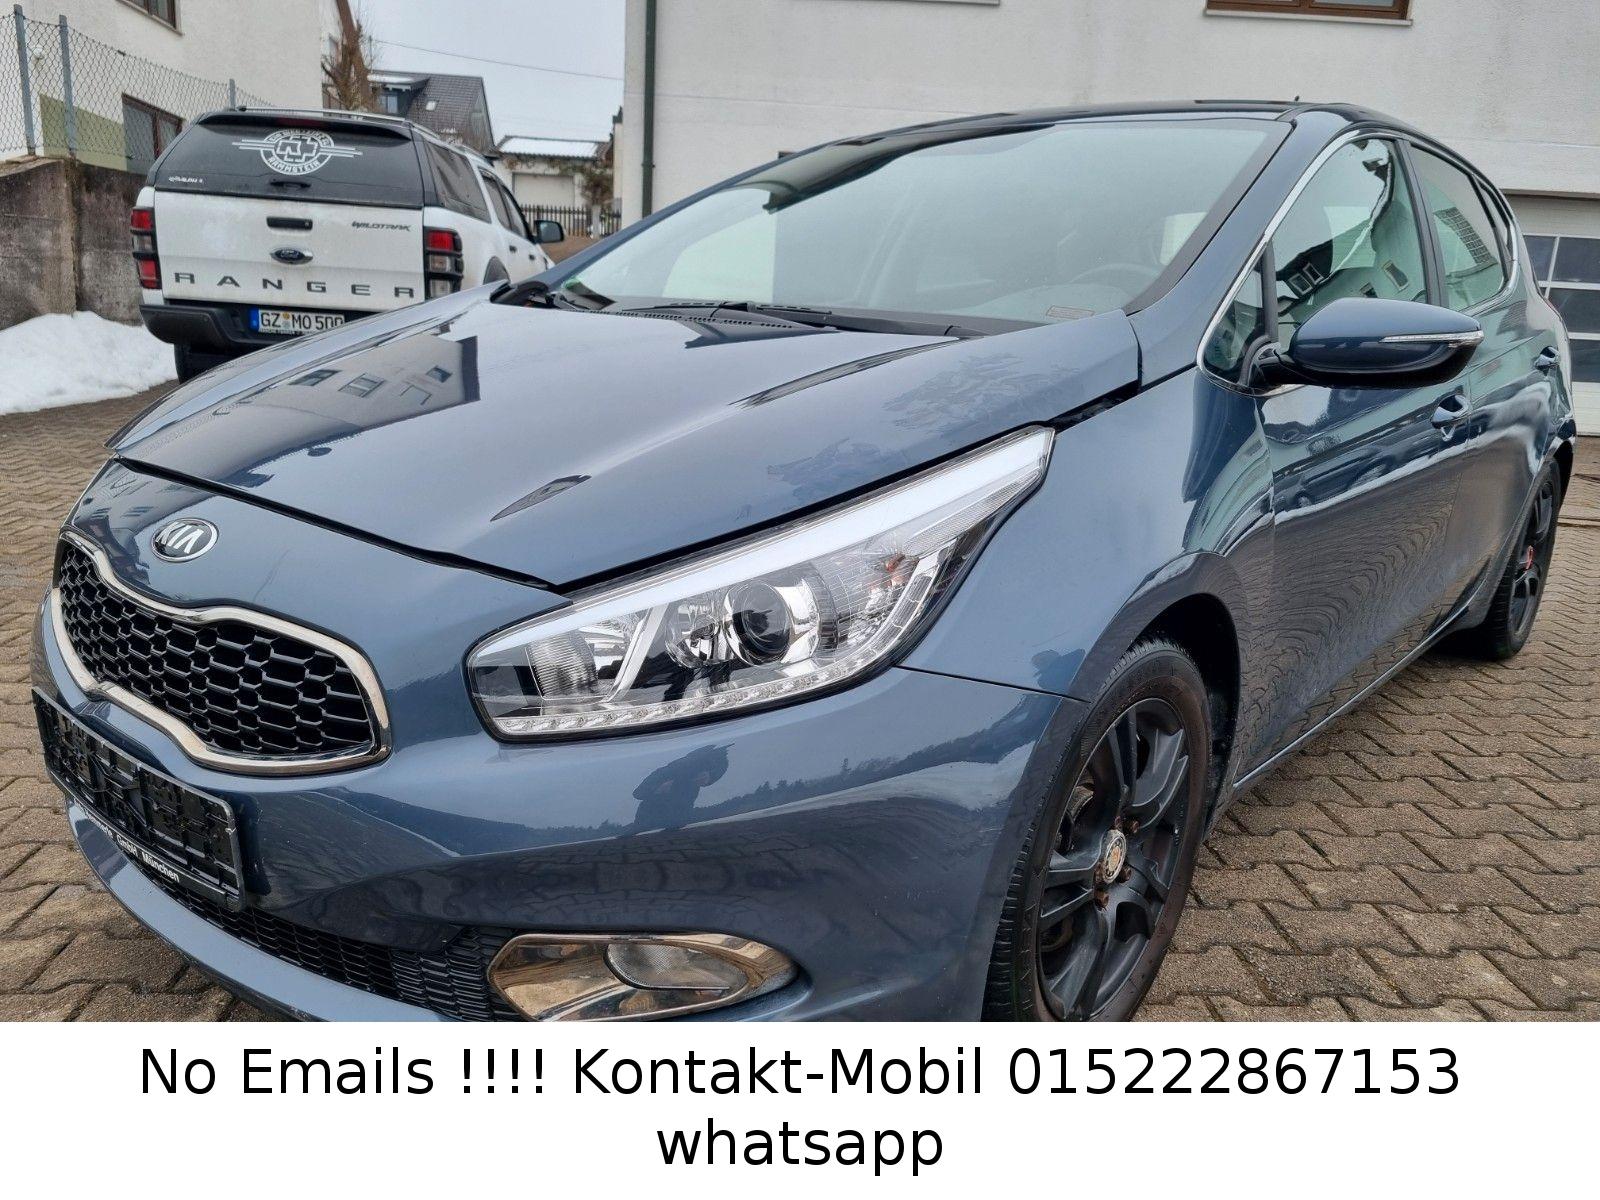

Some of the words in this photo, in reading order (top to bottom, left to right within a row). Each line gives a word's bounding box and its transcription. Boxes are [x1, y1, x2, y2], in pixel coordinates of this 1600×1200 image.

[267, 157, 321, 174] RAMMSTEIN
[174, 272, 414, 298] RANGER
[260, 312, 281, 328] GZ
[291, 313, 312, 330] MO
[155, 521, 205, 555] KIA
[141, 851, 180, 883] München
